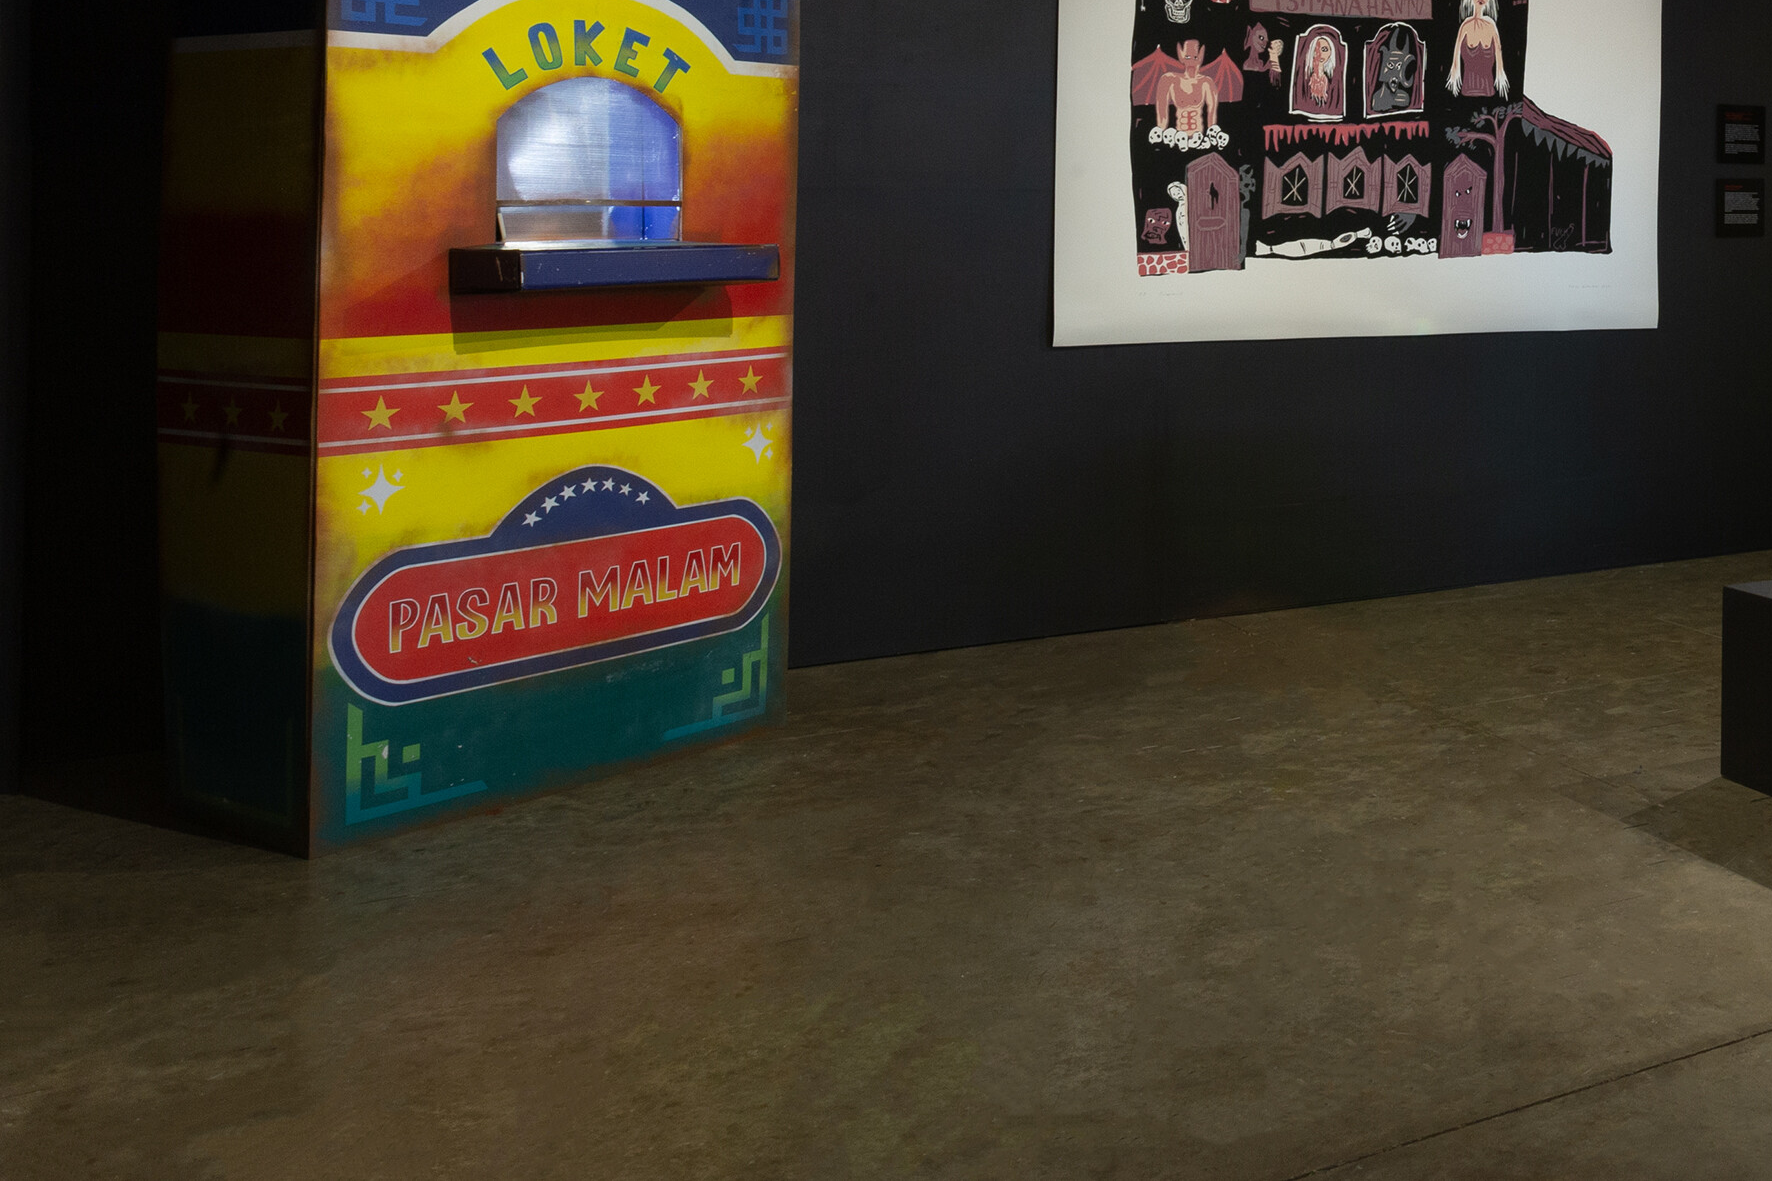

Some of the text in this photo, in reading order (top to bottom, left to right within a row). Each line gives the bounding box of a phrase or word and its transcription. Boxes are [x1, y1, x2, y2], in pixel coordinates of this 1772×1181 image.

[481, 19, 692, 94] LOKET
[388, 541, 742, 654] PASAR MALAM
